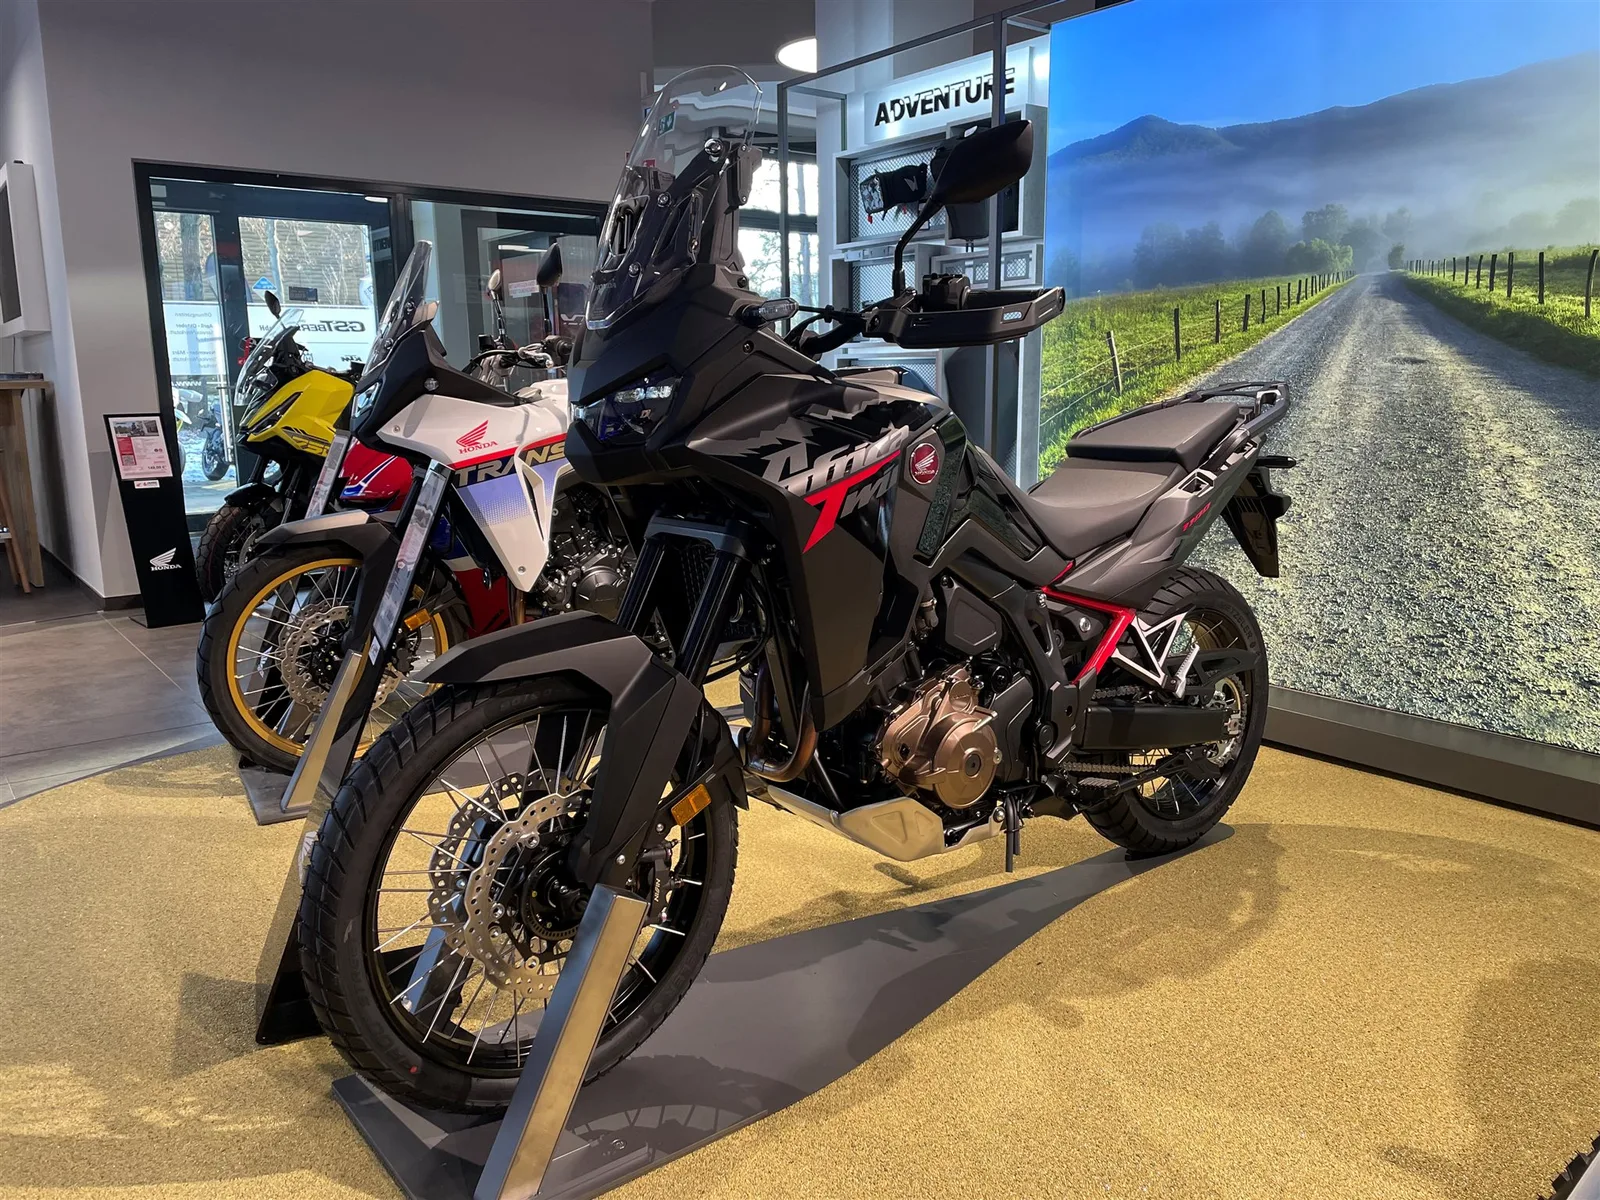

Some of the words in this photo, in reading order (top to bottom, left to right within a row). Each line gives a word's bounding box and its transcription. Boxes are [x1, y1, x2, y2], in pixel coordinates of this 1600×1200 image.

[874, 67, 1015, 126] ADVENTURE
[459, 440, 499, 455] HONDA
[455, 441, 566, 487] TRANS
[150, 563, 182, 571] HONDA
